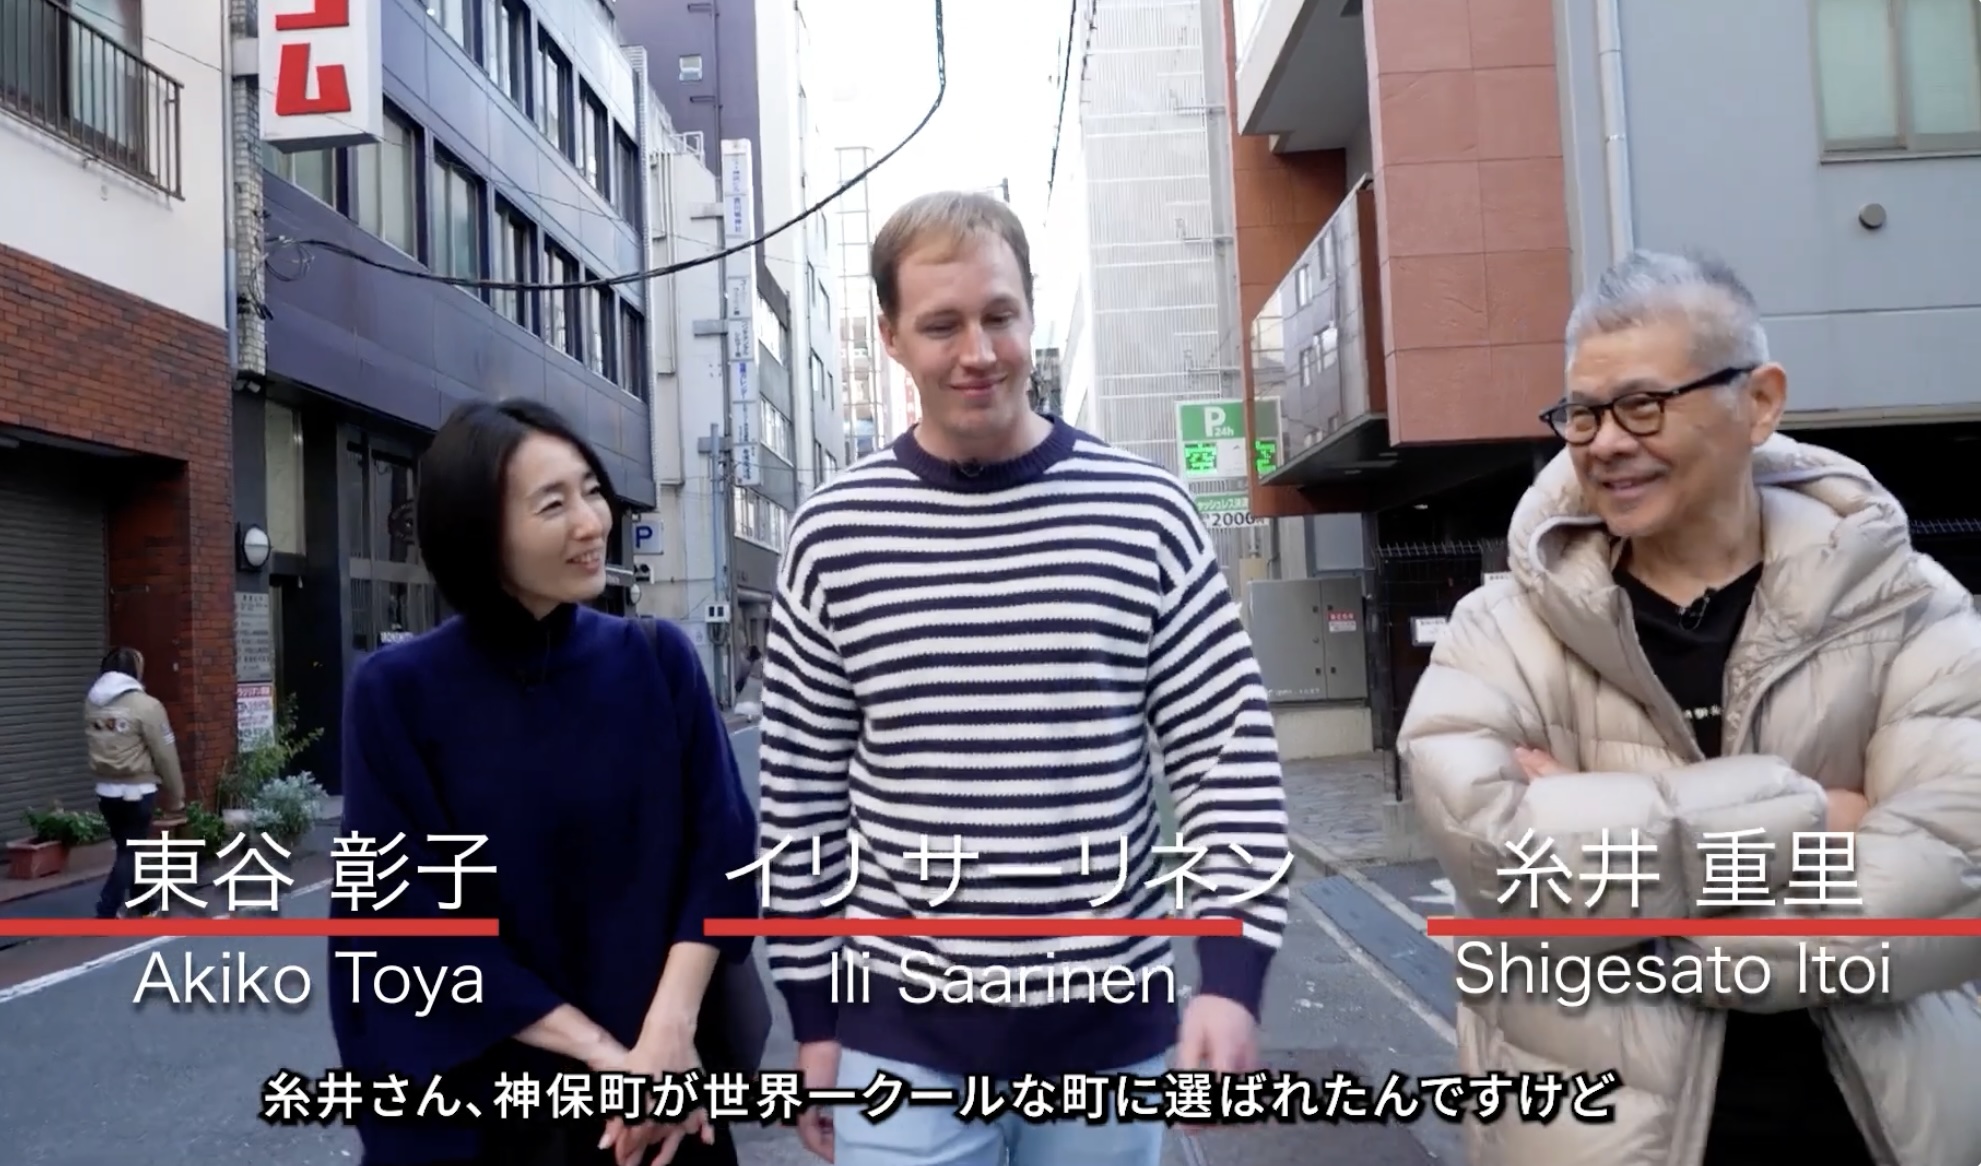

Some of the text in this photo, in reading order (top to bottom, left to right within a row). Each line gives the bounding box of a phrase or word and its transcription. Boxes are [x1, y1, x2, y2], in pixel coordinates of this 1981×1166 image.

[1204, 405, 1226, 437] P
[1214, 425, 1235, 437] 24h
[635, 525, 653, 549] P
